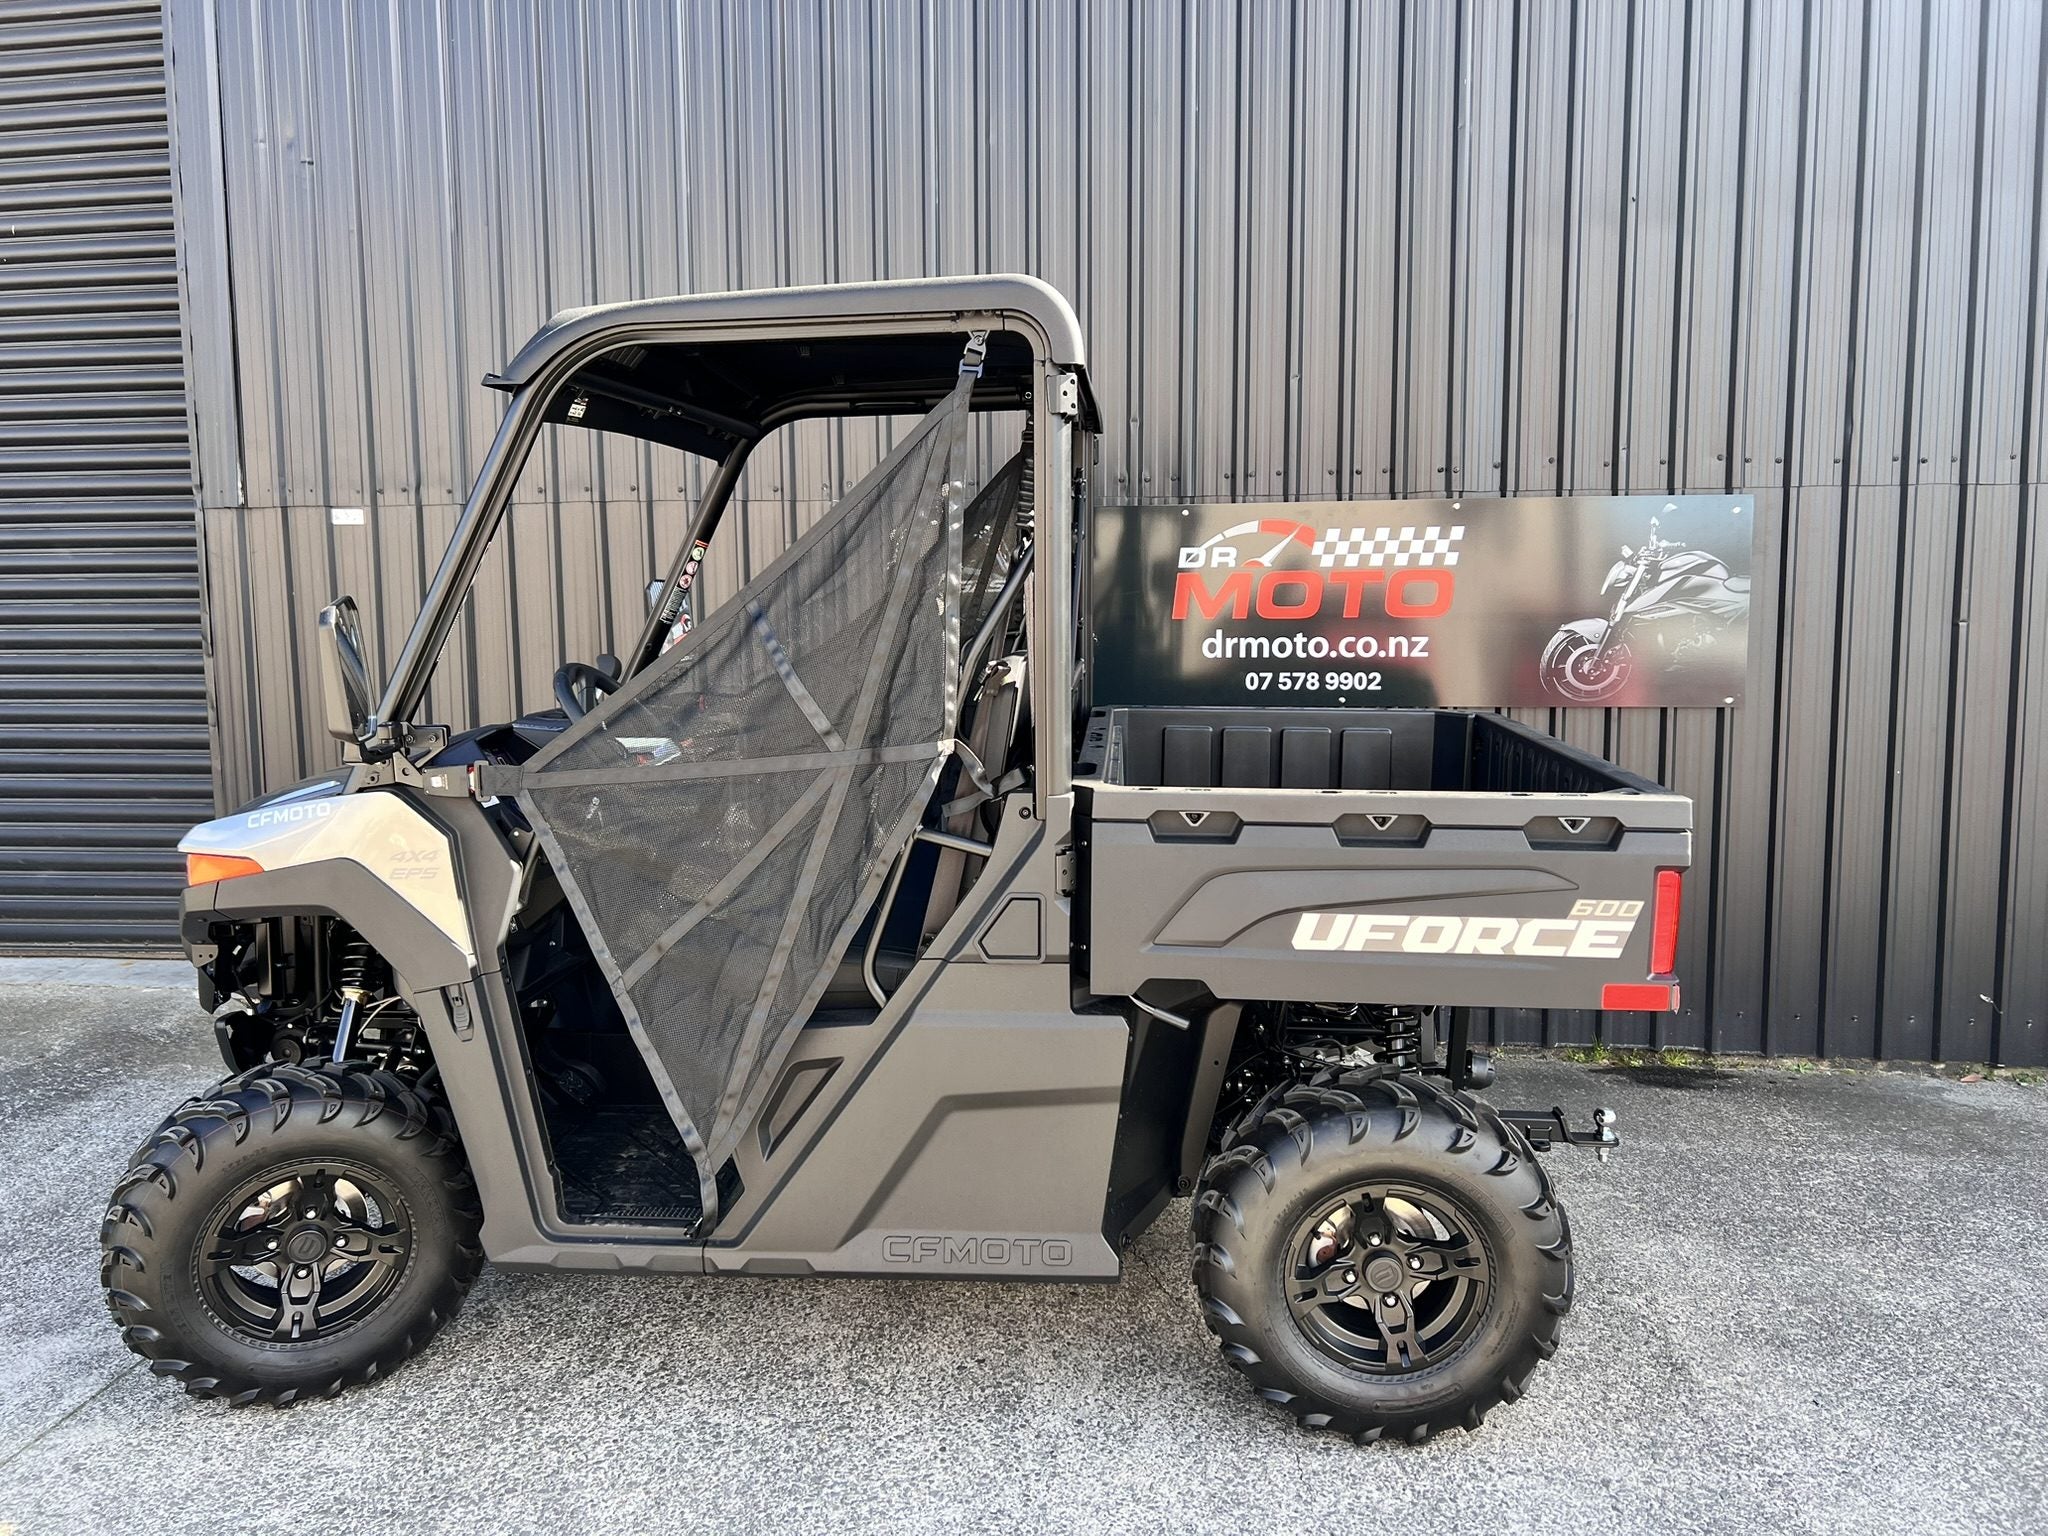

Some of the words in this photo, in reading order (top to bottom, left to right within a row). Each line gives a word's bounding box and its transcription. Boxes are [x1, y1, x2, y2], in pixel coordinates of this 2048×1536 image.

[1178, 546, 1238, 568] DR
[1172, 569, 1456, 620] MOTO
[1201, 629, 1430, 659] drmoto.co.nz
[1245, 672, 1272, 691] 07
[1277, 672, 1320, 691] 578
[1325, 672, 1382, 691] 9902
[247, 802, 331, 829] CFMOTO
[390, 867, 440, 880] EPS
[1570, 899, 1641, 917] 600
[1291, 912, 1636, 959] UFORCE
[882, 1235, 1073, 1267] CFMOTO
